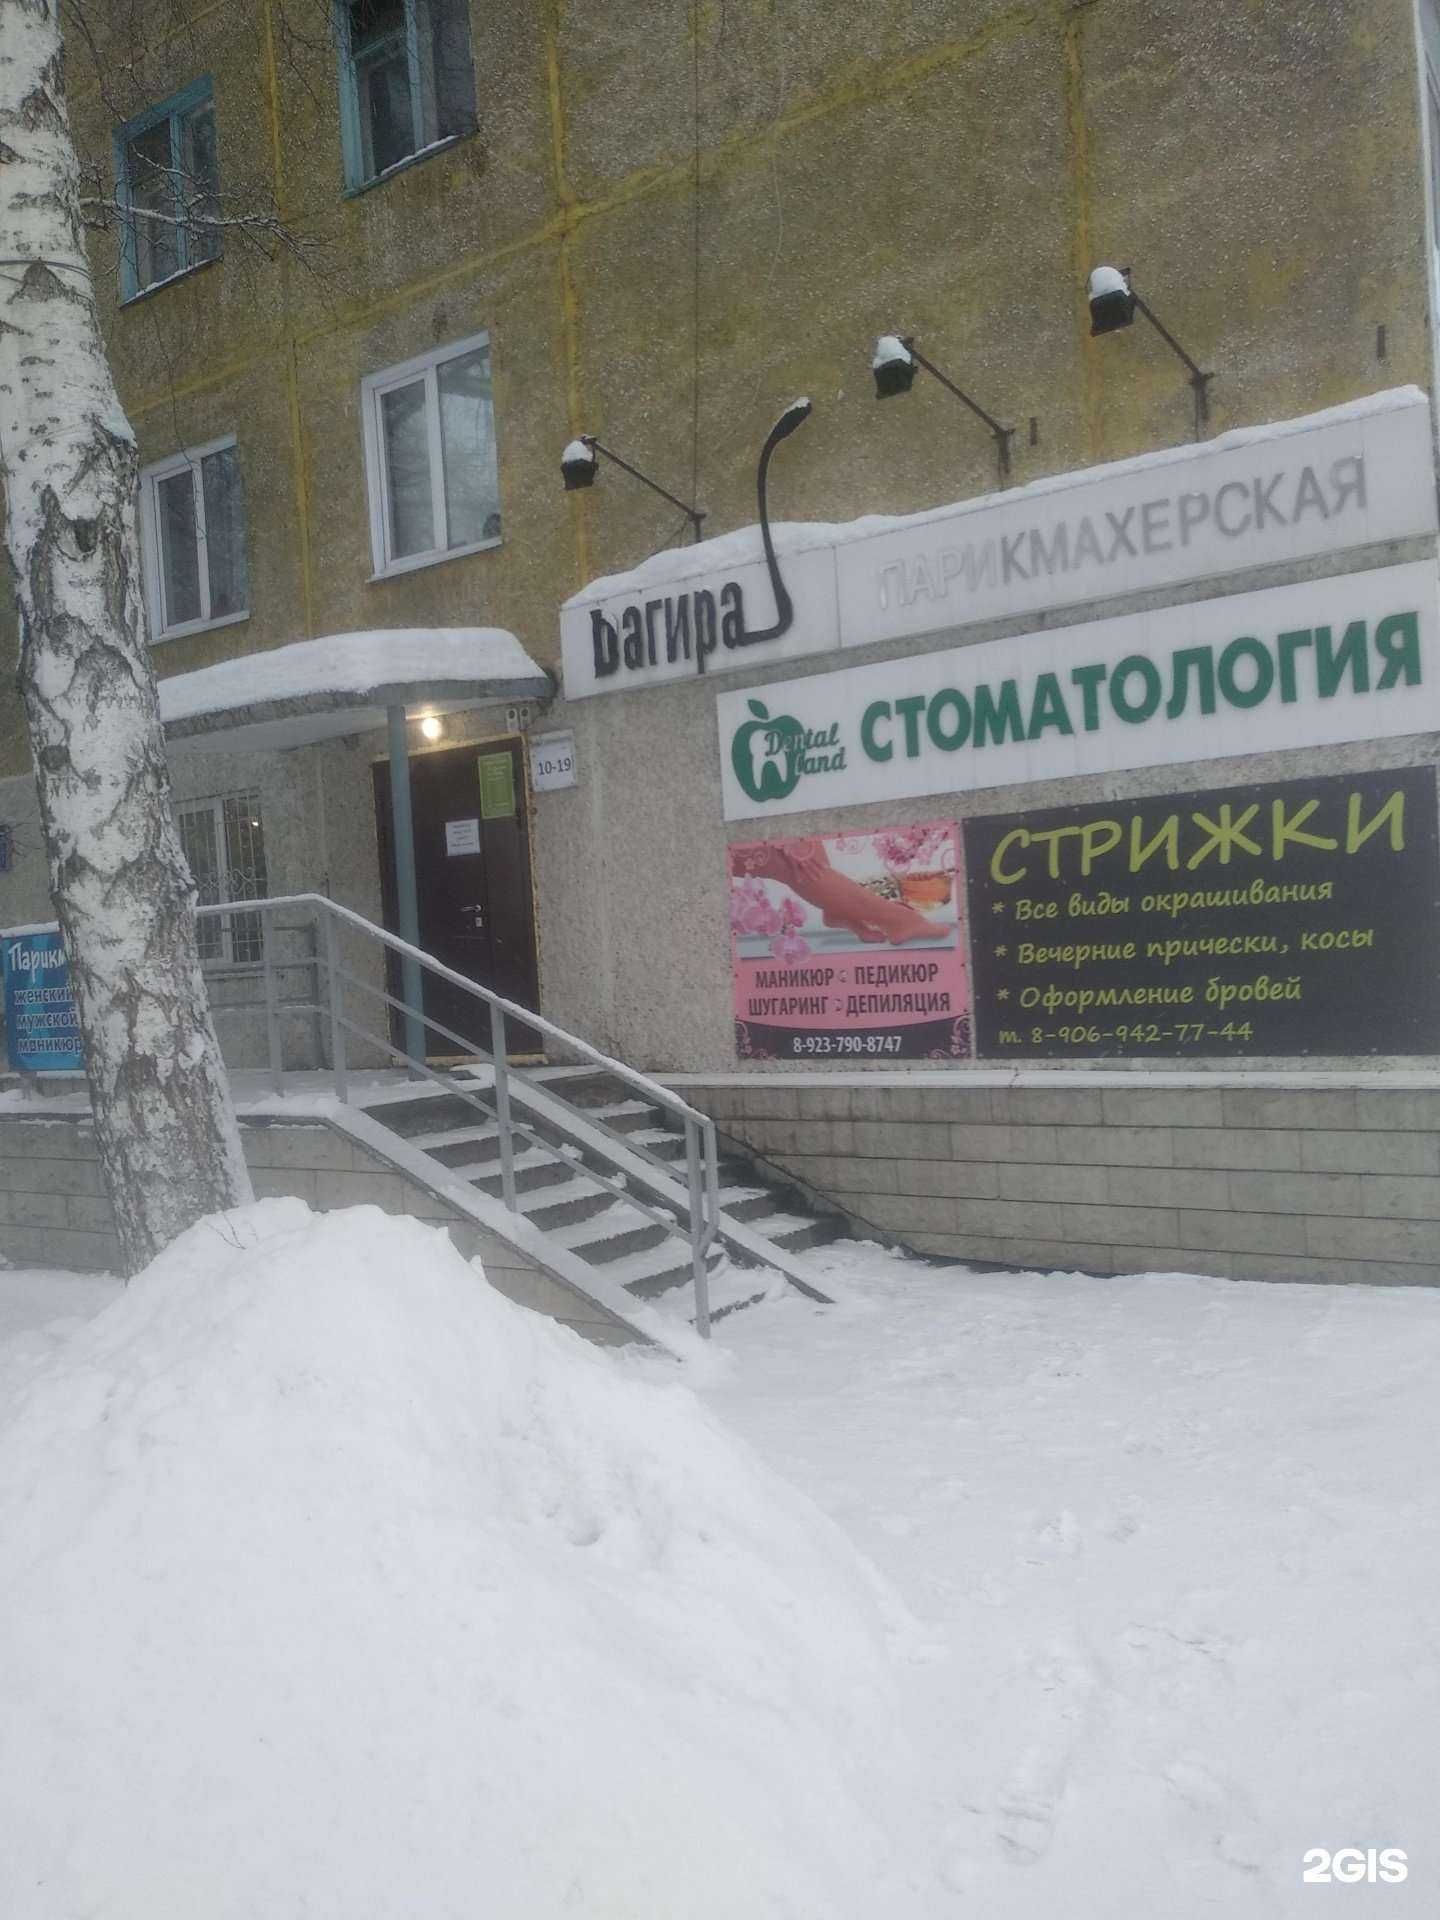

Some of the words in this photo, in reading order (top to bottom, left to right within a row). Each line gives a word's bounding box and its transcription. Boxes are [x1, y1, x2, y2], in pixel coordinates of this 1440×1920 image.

[877, 455, 1367, 610] ПАРИКМАХЕРСКАЯ
[861, 611, 1422, 763] СТОМАТОЛОГИЯ
[538, 758, 572, 776] 10-19
[990, 790, 1406, 885] СТРИЖКИ
[1015, 899, 1058, 921] Все
[1068, 892, 1129, 917] виды
[1141, 878, 1334, 918] окрашивания
[1018, 942, 1136, 970] Вечерние
[1146, 932, 1289, 966] прически,
[1301, 928, 1374, 951] косы
[755, 968, 834, 988] МАНИКЮР
[854, 963, 938, 988] ПЕДИКЮР
[1019, 984, 1194, 1015] Оформление
[1205, 975, 1302, 1011] бровей
[748, 996, 829, 1016] ШУГАРИНГ
[846, 992, 950, 1017] ДЕПИЛЯЦИЯ
[793, 1035, 902, 1053] 8-923-790-8747
[1031, 1021, 1254, 1044] 8-906-942-77-44
